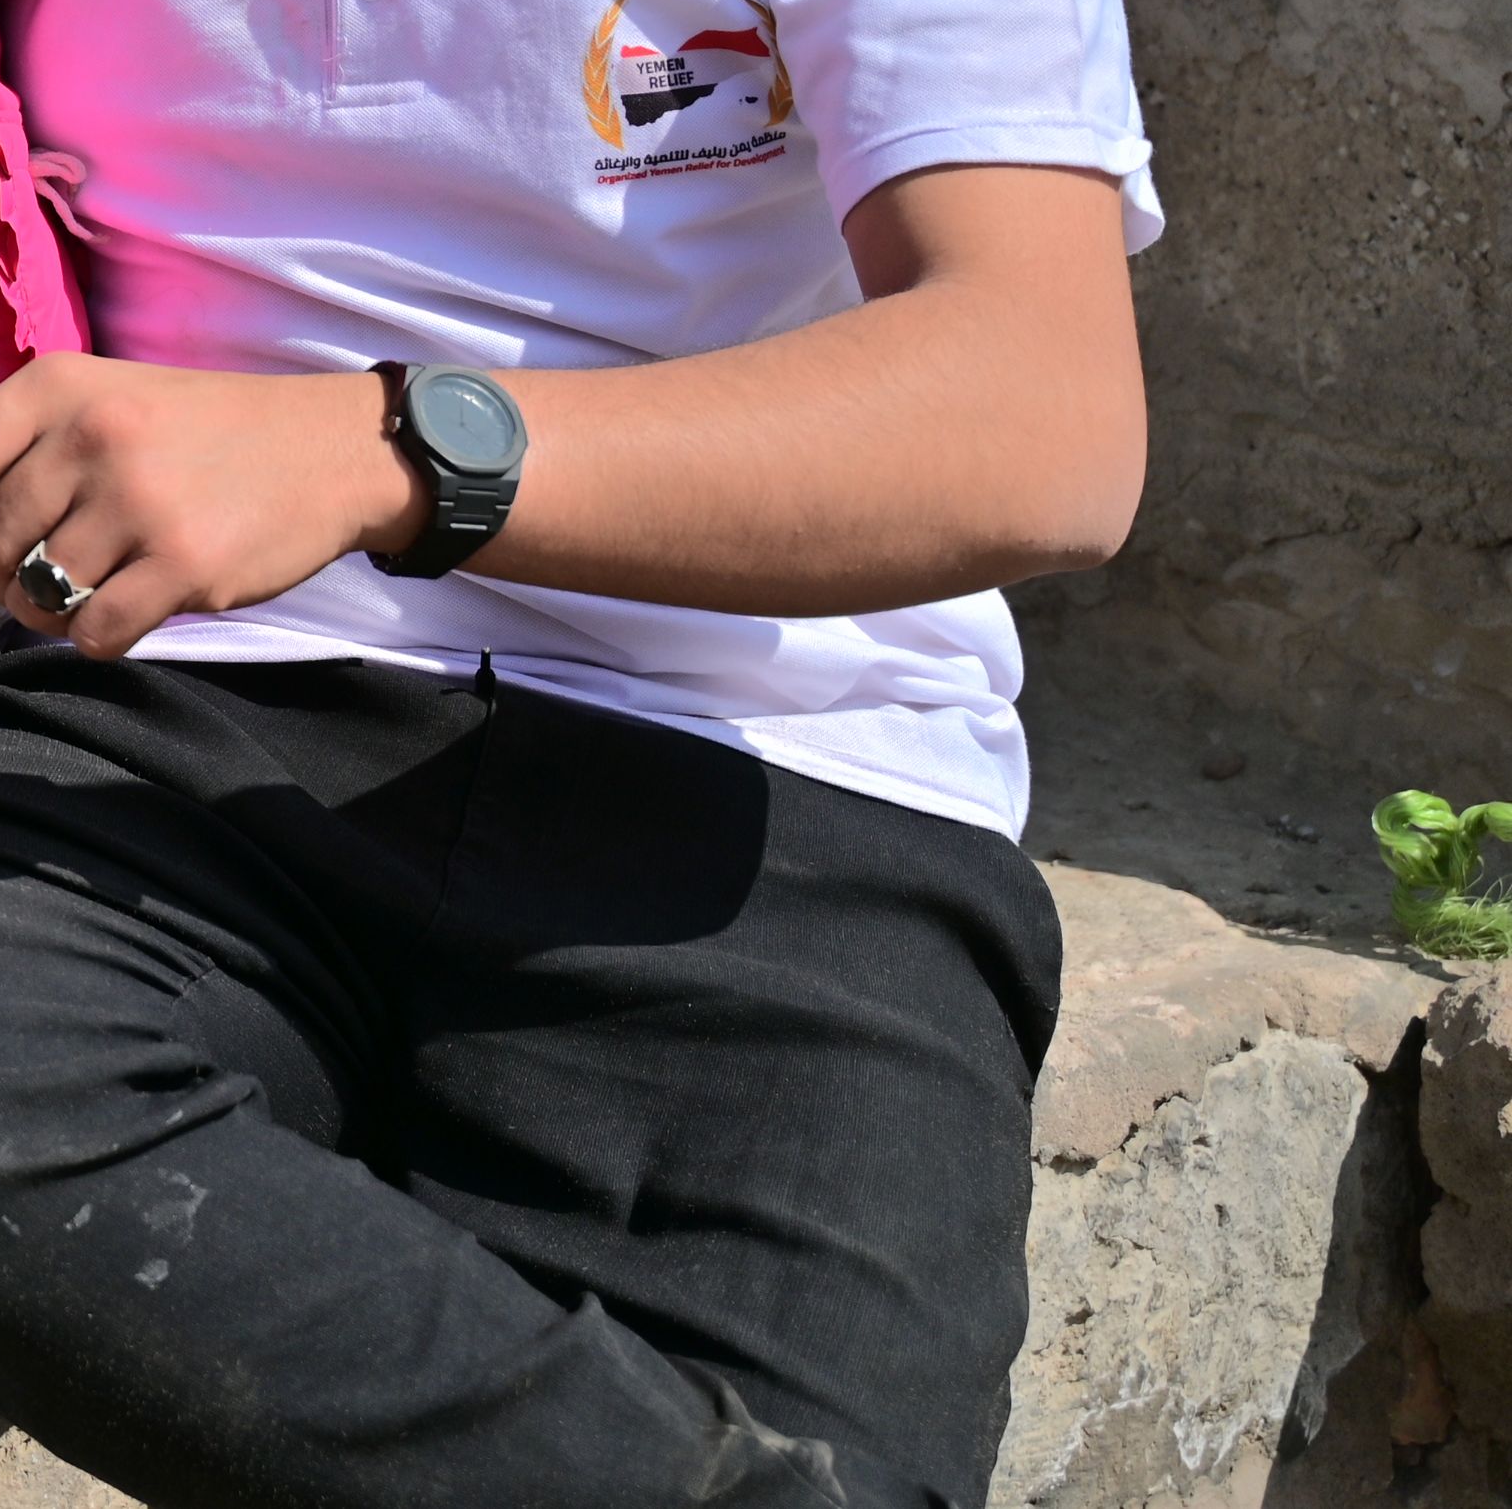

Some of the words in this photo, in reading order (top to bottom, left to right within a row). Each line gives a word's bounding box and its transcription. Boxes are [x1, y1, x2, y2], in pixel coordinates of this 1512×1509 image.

[636, 57, 685, 75] YEMEN
[649, 71, 694, 89] RELIEF
[597, 170, 648, 185] Organized
[650, 166, 683, 177] Yemen
[684, 161, 714, 172] Relief
[716, 160, 731, 169] for
[733, 144, 786, 168] Development
